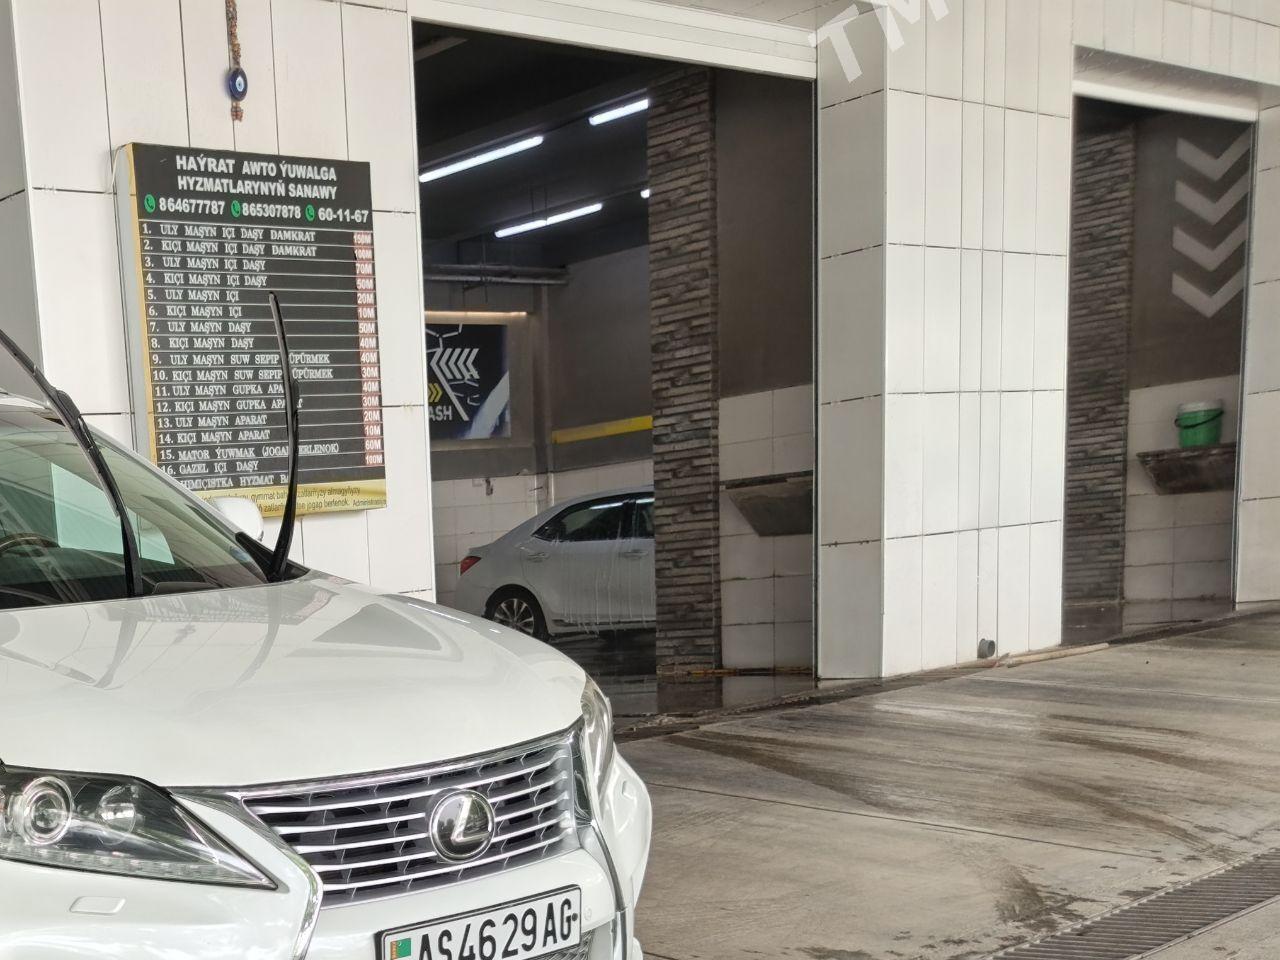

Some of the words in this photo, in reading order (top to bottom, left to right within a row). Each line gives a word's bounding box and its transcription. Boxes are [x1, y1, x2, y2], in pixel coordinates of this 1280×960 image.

[176, 155, 235, 174] HAÝRAT
[242, 161, 276, 177] AWTO
[280, 161, 337, 181] ÝUWALGA
[288, 185, 337, 200] SANAWY
[159, 198, 225, 215] 864677787
[242, 203, 301, 219] 865307878
[318, 208, 369, 223] 60-11-67
[142, 224, 152, 234] 1.
[160, 224, 178, 235] ULY
[184, 226, 217, 238] MAŞYN
[222, 227, 236, 239] IÇI
[240, 228, 264, 240] DAŞY
[270, 230, 316, 242] DAMKRAT
[144, 240, 153, 250] 2.
[161, 240, 182, 252] KIÇI
[186, 242, 218, 254] MAŞYN
[225, 243, 238, 255] IÇI
[242, 244, 266, 256] DAŞY
[272, 245, 317, 257] DAMKRAT
[145, 256, 154, 267] 3.
[162, 257, 181, 267] ULY
[187, 258, 219, 270] MAŞYN
[224, 259, 238, 271] IÇI
[243, 260, 266, 272] DAŞY
[146, 273, 156, 284] 4.
[164, 274, 184, 286] KIÇI
[188, 274, 220, 286] MAŞYN
[227, 275, 240, 287] IÇI
[244, 276, 268, 288] DAŞY
[148, 290, 157, 300] 5.
[165, 290, 183, 300] ULY
[188, 290, 220, 302] MAŞYN
[226, 291, 240, 303] IÇI
[148, 306, 158, 316] 6.
[166, 306, 187, 318] KIÇI
[191, 306, 223, 318] MAŞYN
[229, 306, 242, 318] IÇI
[358, 308, 375, 318] 10M
[150, 322, 159, 332] 7.
[168, 322, 186, 332] ULY
[190, 322, 222, 334] MAŞYN
[228, 322, 252, 334] DAŞY
[359, 322, 375, 333] 50M
[151, 338, 160, 348] 8.
[169, 338, 189, 350] KIÇI
[193, 338, 225, 350] MAŞYN
[231, 338, 254, 350] DAŞY
[360, 338, 377, 349] 40M
[152, 354, 161, 364] 9.
[170, 354, 188, 365] ULY
[193, 354, 224, 366] MAŞYN
[230, 354, 250, 364] SUW
[255, 354, 280, 364] SEPIP
[288, 353, 330, 364] ÜPÜRMEK
[361, 352, 377, 363] 40M
[153, 370, 168, 380] 10.
[172, 370, 192, 382] KIÇI
[196, 370, 228, 382] MAŞYN
[234, 370, 254, 380] SUW
[258, 370, 282, 379] SEPIP
[292, 368, 333, 379] ÜPÜRMEK
[362, 367, 378, 378] 30M
[155, 386, 170, 396] 11.
[173, 386, 190, 396] ULY
[195, 385, 226, 397] MAŞYN
[233, 385, 263, 394] GUPKA
[268, 384, 284, 394] APA
[362, 381, 379, 392] 40M
[156, 402, 171, 412] 12.
[174, 402, 194, 413] KIÇI
[199, 401, 230, 412] MAŞYN
[236, 400, 266, 410] GUPKA
[363, 396, 379, 407] 30M
[158, 418, 172, 428] 13.
[175, 417, 193, 427] ULY
[198, 416, 229, 428] MAŞYN
[235, 415, 267, 425] APARAT
[364, 411, 380, 421] 20M
[428, 405, 453, 421] ASH
[159, 434, 173, 444] 14.
[177, 433, 196, 444] KIÇI
[201, 431, 232, 443] MAŞYN
[238, 430, 270, 441] APARAT
[365, 425, 380, 436] 10M
[160, 450, 175, 460] 15.
[178, 450, 209, 460] MATOR
[262, 446, 288, 457] (JOGA
[298, 443, 339, 455] ERLENOK)
[180, 464, 208, 474] GAZEL
[214, 463, 227, 474] IÇI
[236, 461, 259, 472] DAŞY
[240, 475, 274, 486] HYZMAT
